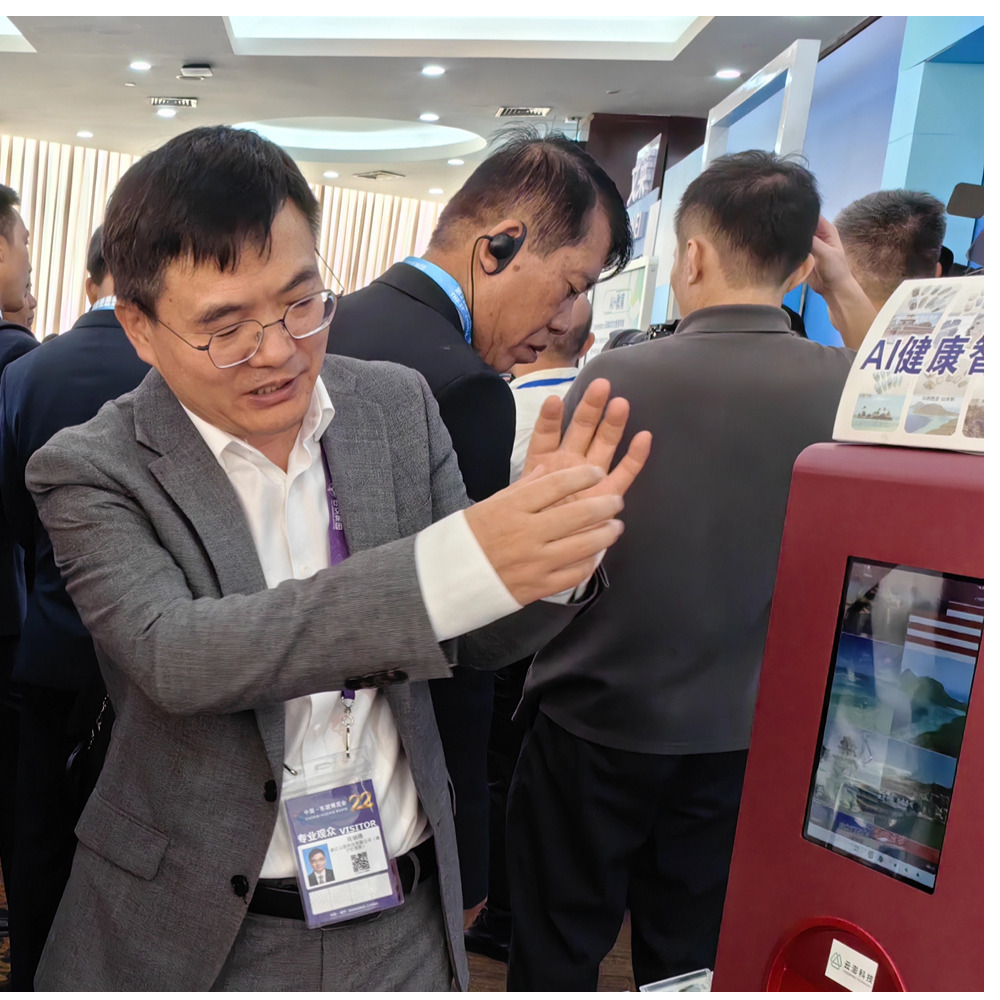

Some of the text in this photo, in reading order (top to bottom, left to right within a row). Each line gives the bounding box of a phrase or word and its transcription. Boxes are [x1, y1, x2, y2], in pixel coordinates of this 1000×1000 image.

[348, 791, 374, 812] 22
[297, 826, 337, 844] 专业观众
[339, 819, 378, 835] VISITOR
